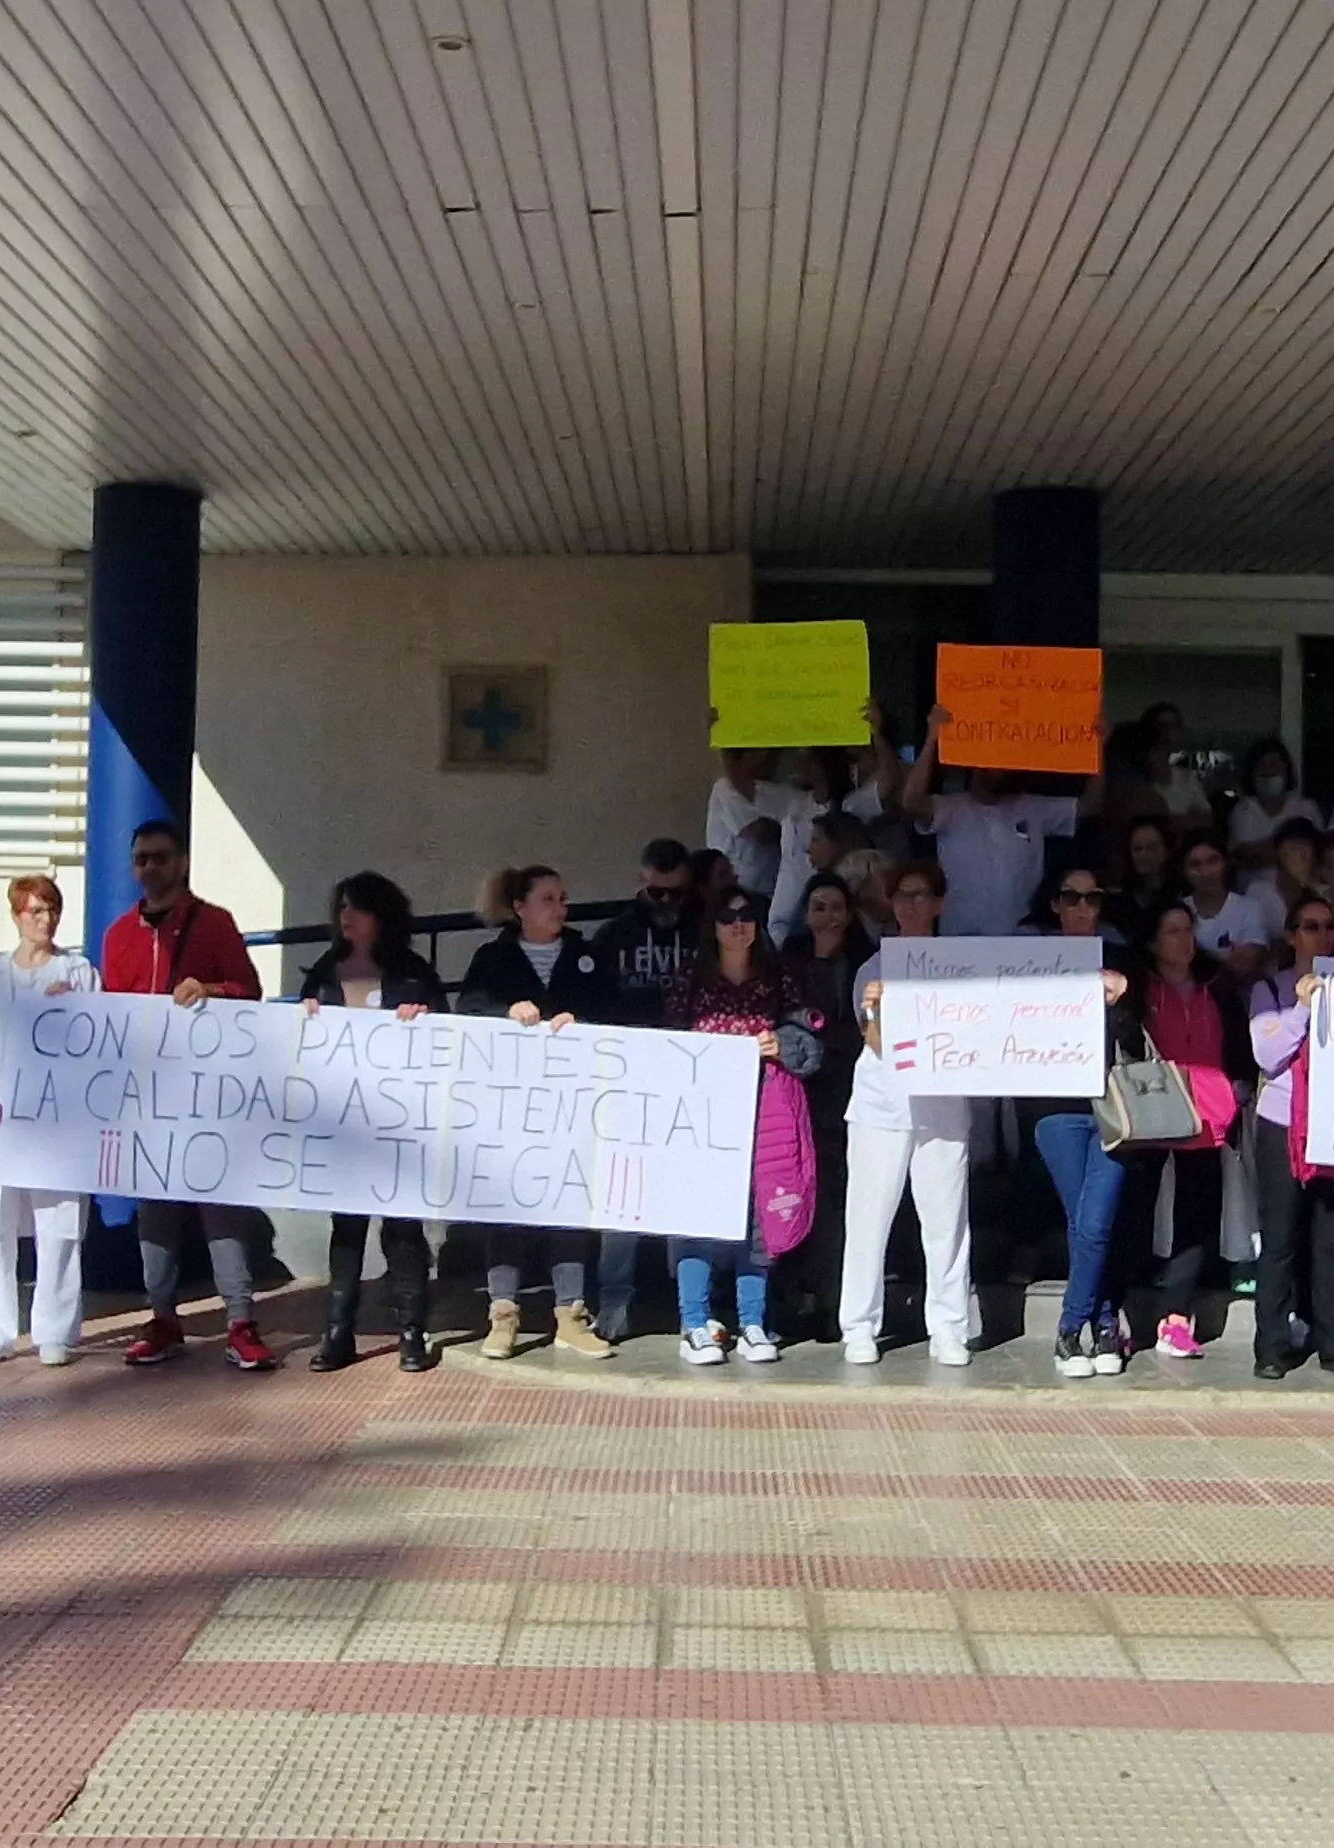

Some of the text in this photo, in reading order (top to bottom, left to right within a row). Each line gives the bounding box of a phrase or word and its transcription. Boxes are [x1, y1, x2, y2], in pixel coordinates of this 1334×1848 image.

[1001, 650, 1032, 670] NO
[31, 1007, 713, 1085] CON LOS PACIENTES Y
[9, 1067, 742, 1152] LA CALIDAD ASISTENCIAL
[256, 1131, 334, 1196] SE
